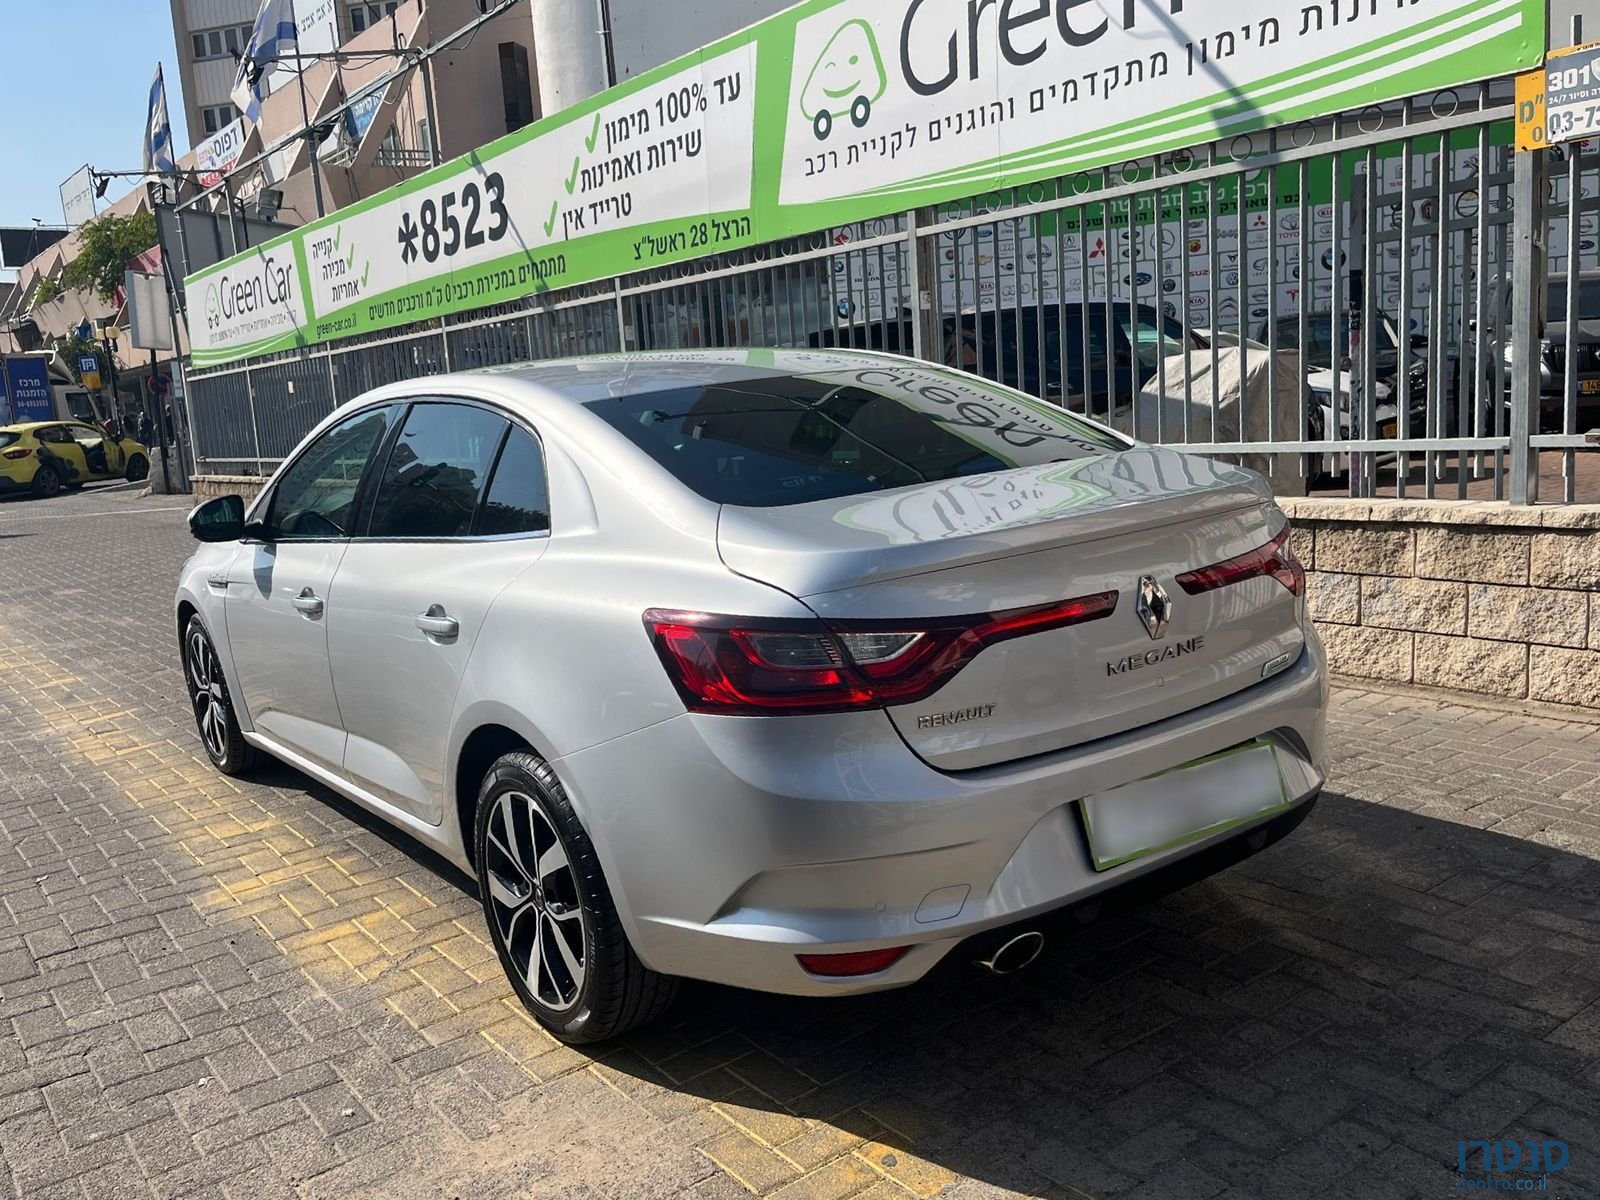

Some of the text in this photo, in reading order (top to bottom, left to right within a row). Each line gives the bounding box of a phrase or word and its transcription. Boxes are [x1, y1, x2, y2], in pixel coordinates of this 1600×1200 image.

[1185, 17, 1280, 76] מימון
[1029, 51, 1168, 113] מתקדמים
[1548, 64, 1590, 92] 301
[604, 72, 741, 154] עד 100% מימון
[929, 96, 1015, 142] והוגנים
[213, 127, 238, 158] דפוס
[846, 122, 918, 167] לקניית
[580, 129, 702, 193] שירות ואמינות
[805, 150, 839, 177] רכב
[562, 192, 632, 241] טרייד אין
[712, 215, 751, 243] הרצל
[312, 237, 333, 260] קנייה
[690, 222, 709, 248] 28
[322, 259, 346, 281] מכירה
[477, 267, 516, 294] במכירת
[519, 254, 567, 281] מתמחים
[220, 257, 293, 320] Green Car
[332, 280, 360, 302] אחריות
[453, 280, 475, 301] רכבי
[369, 305, 396, 321] חדשים
[397, 297, 424, 315] ורכבים
[316, 313, 357, 340] green-car.co.il
[19, 379, 41, 387] מרכז
[1106, 636, 1206, 678] MEGANE
[917, 703, 996, 730] RENAULT
